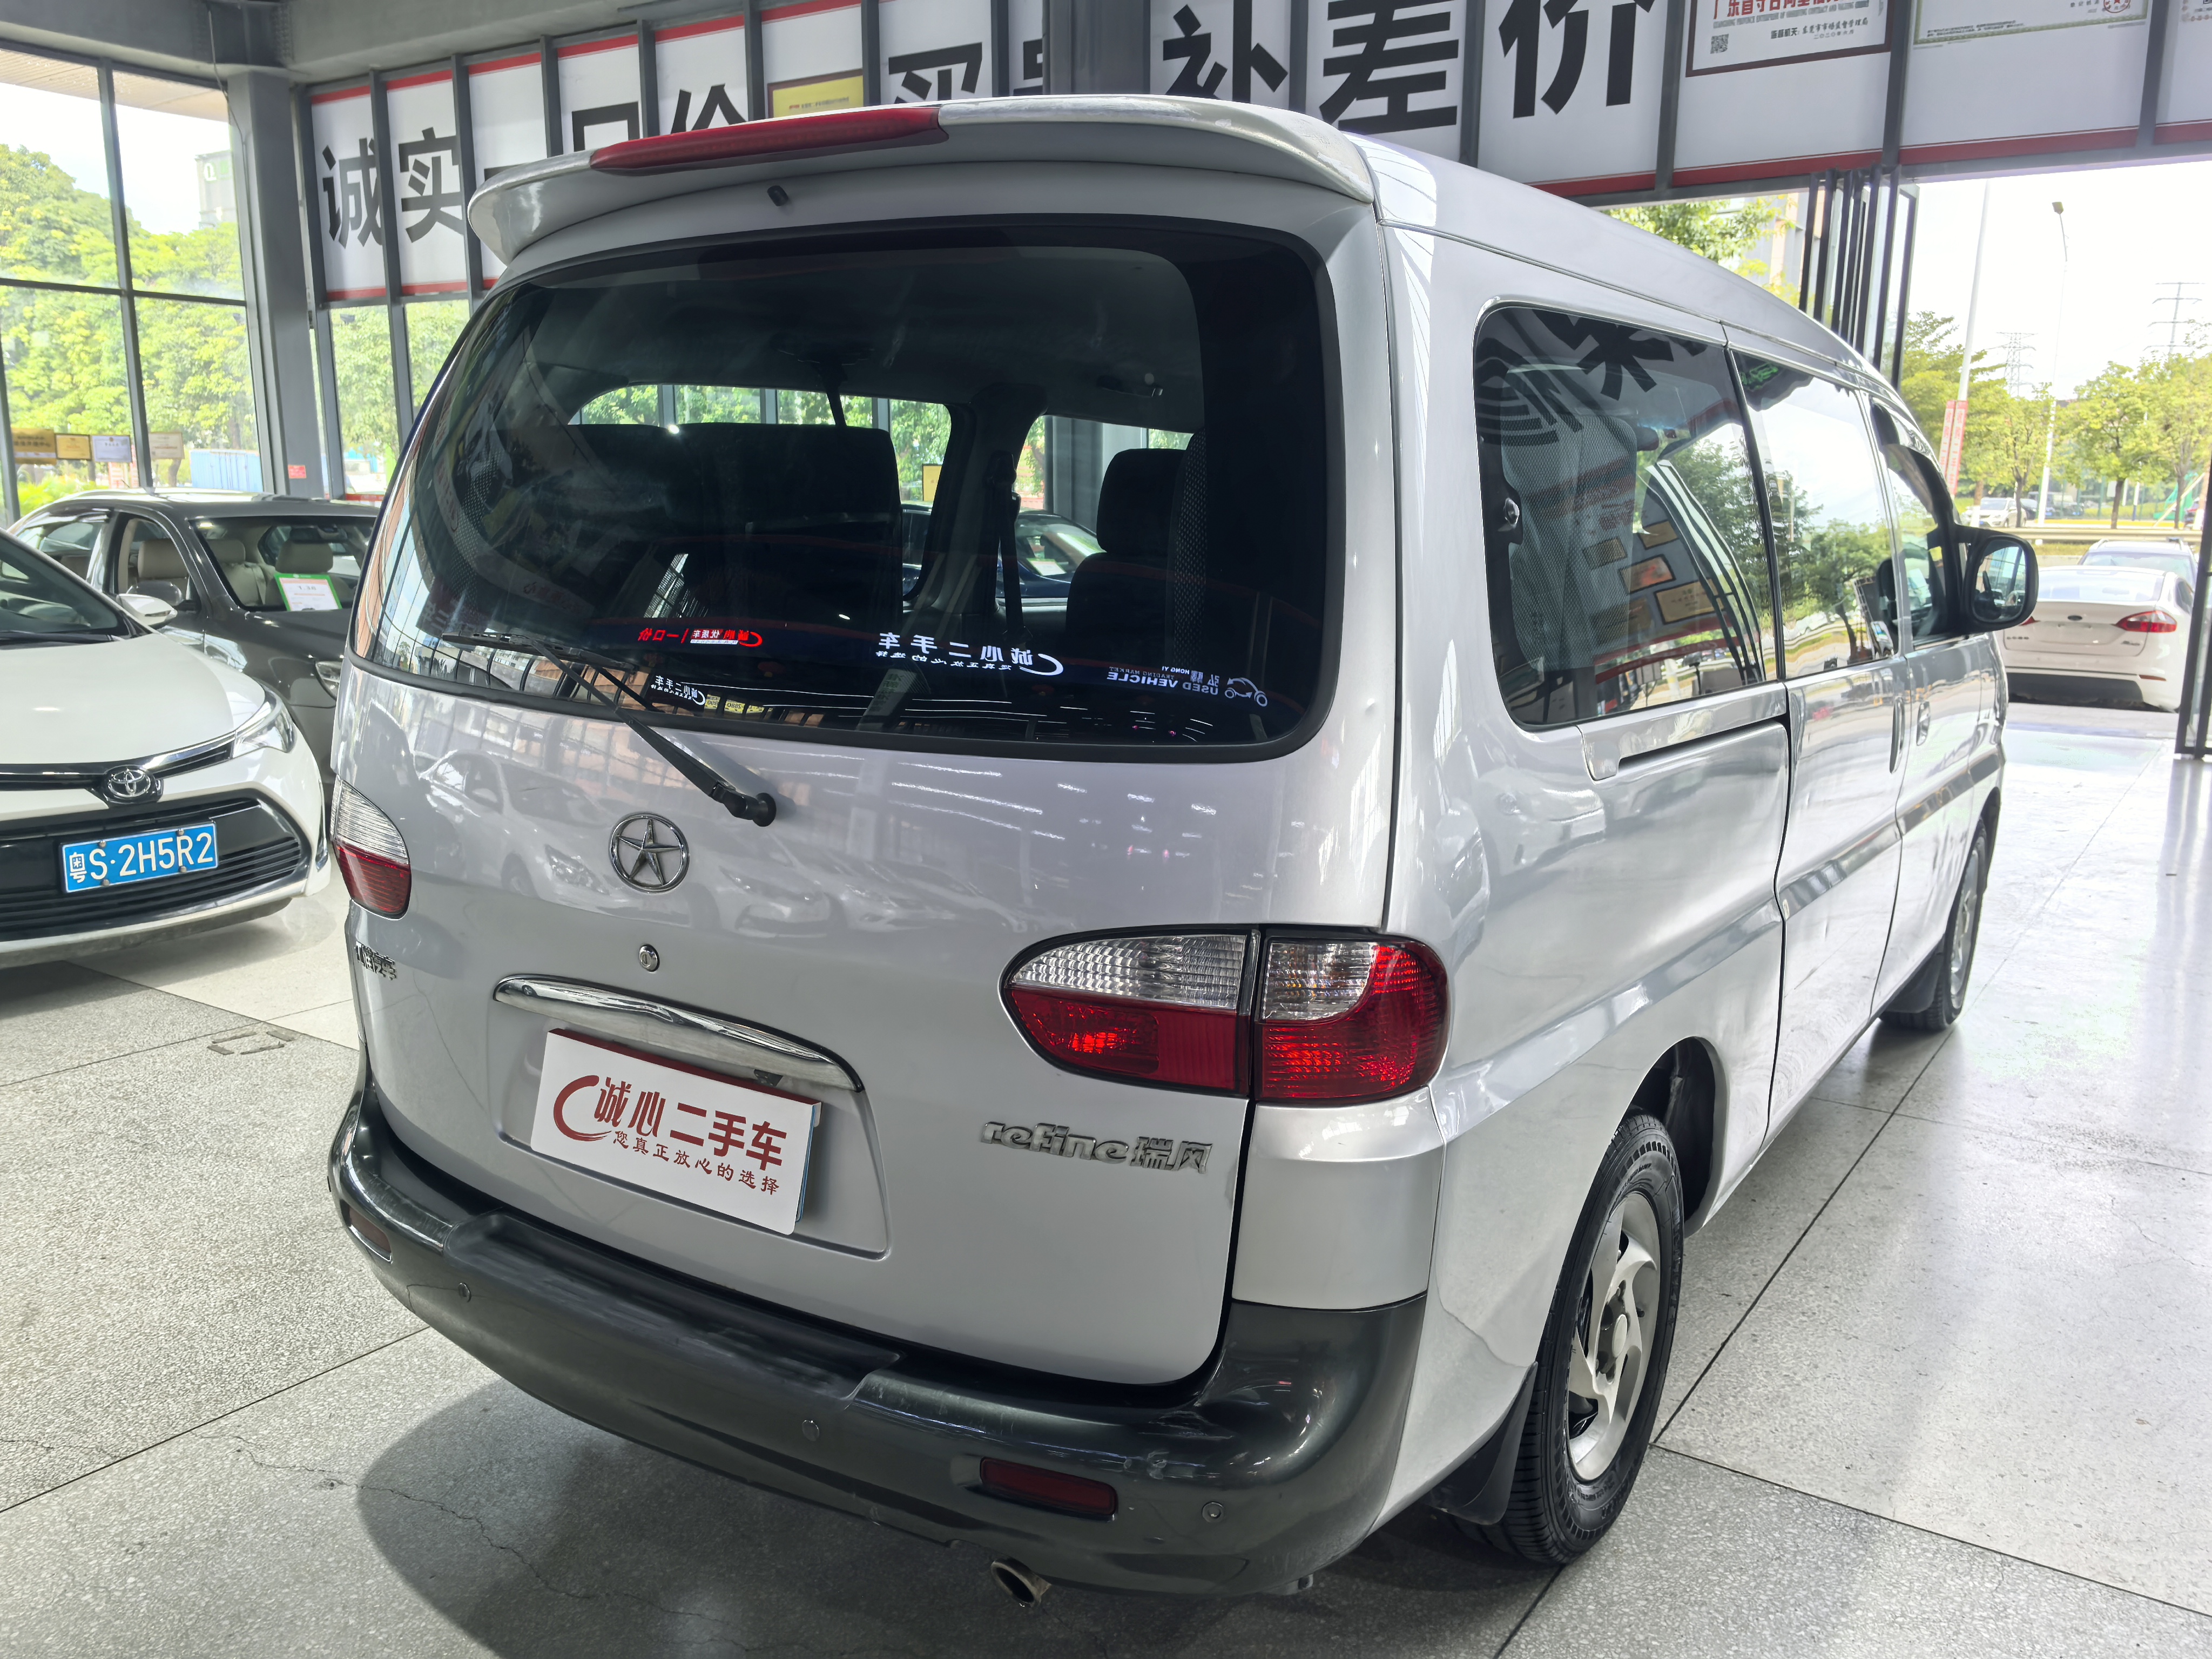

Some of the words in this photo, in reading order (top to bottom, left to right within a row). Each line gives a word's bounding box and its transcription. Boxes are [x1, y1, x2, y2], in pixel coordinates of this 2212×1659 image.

[594, 1076, 787, 1171] 诚心二手车
[981, 1121, 1129, 1164] refine
[1130, 1136, 1213, 1174] 瑞风
[612, 1129, 780, 1196] 您真正放心的选择
